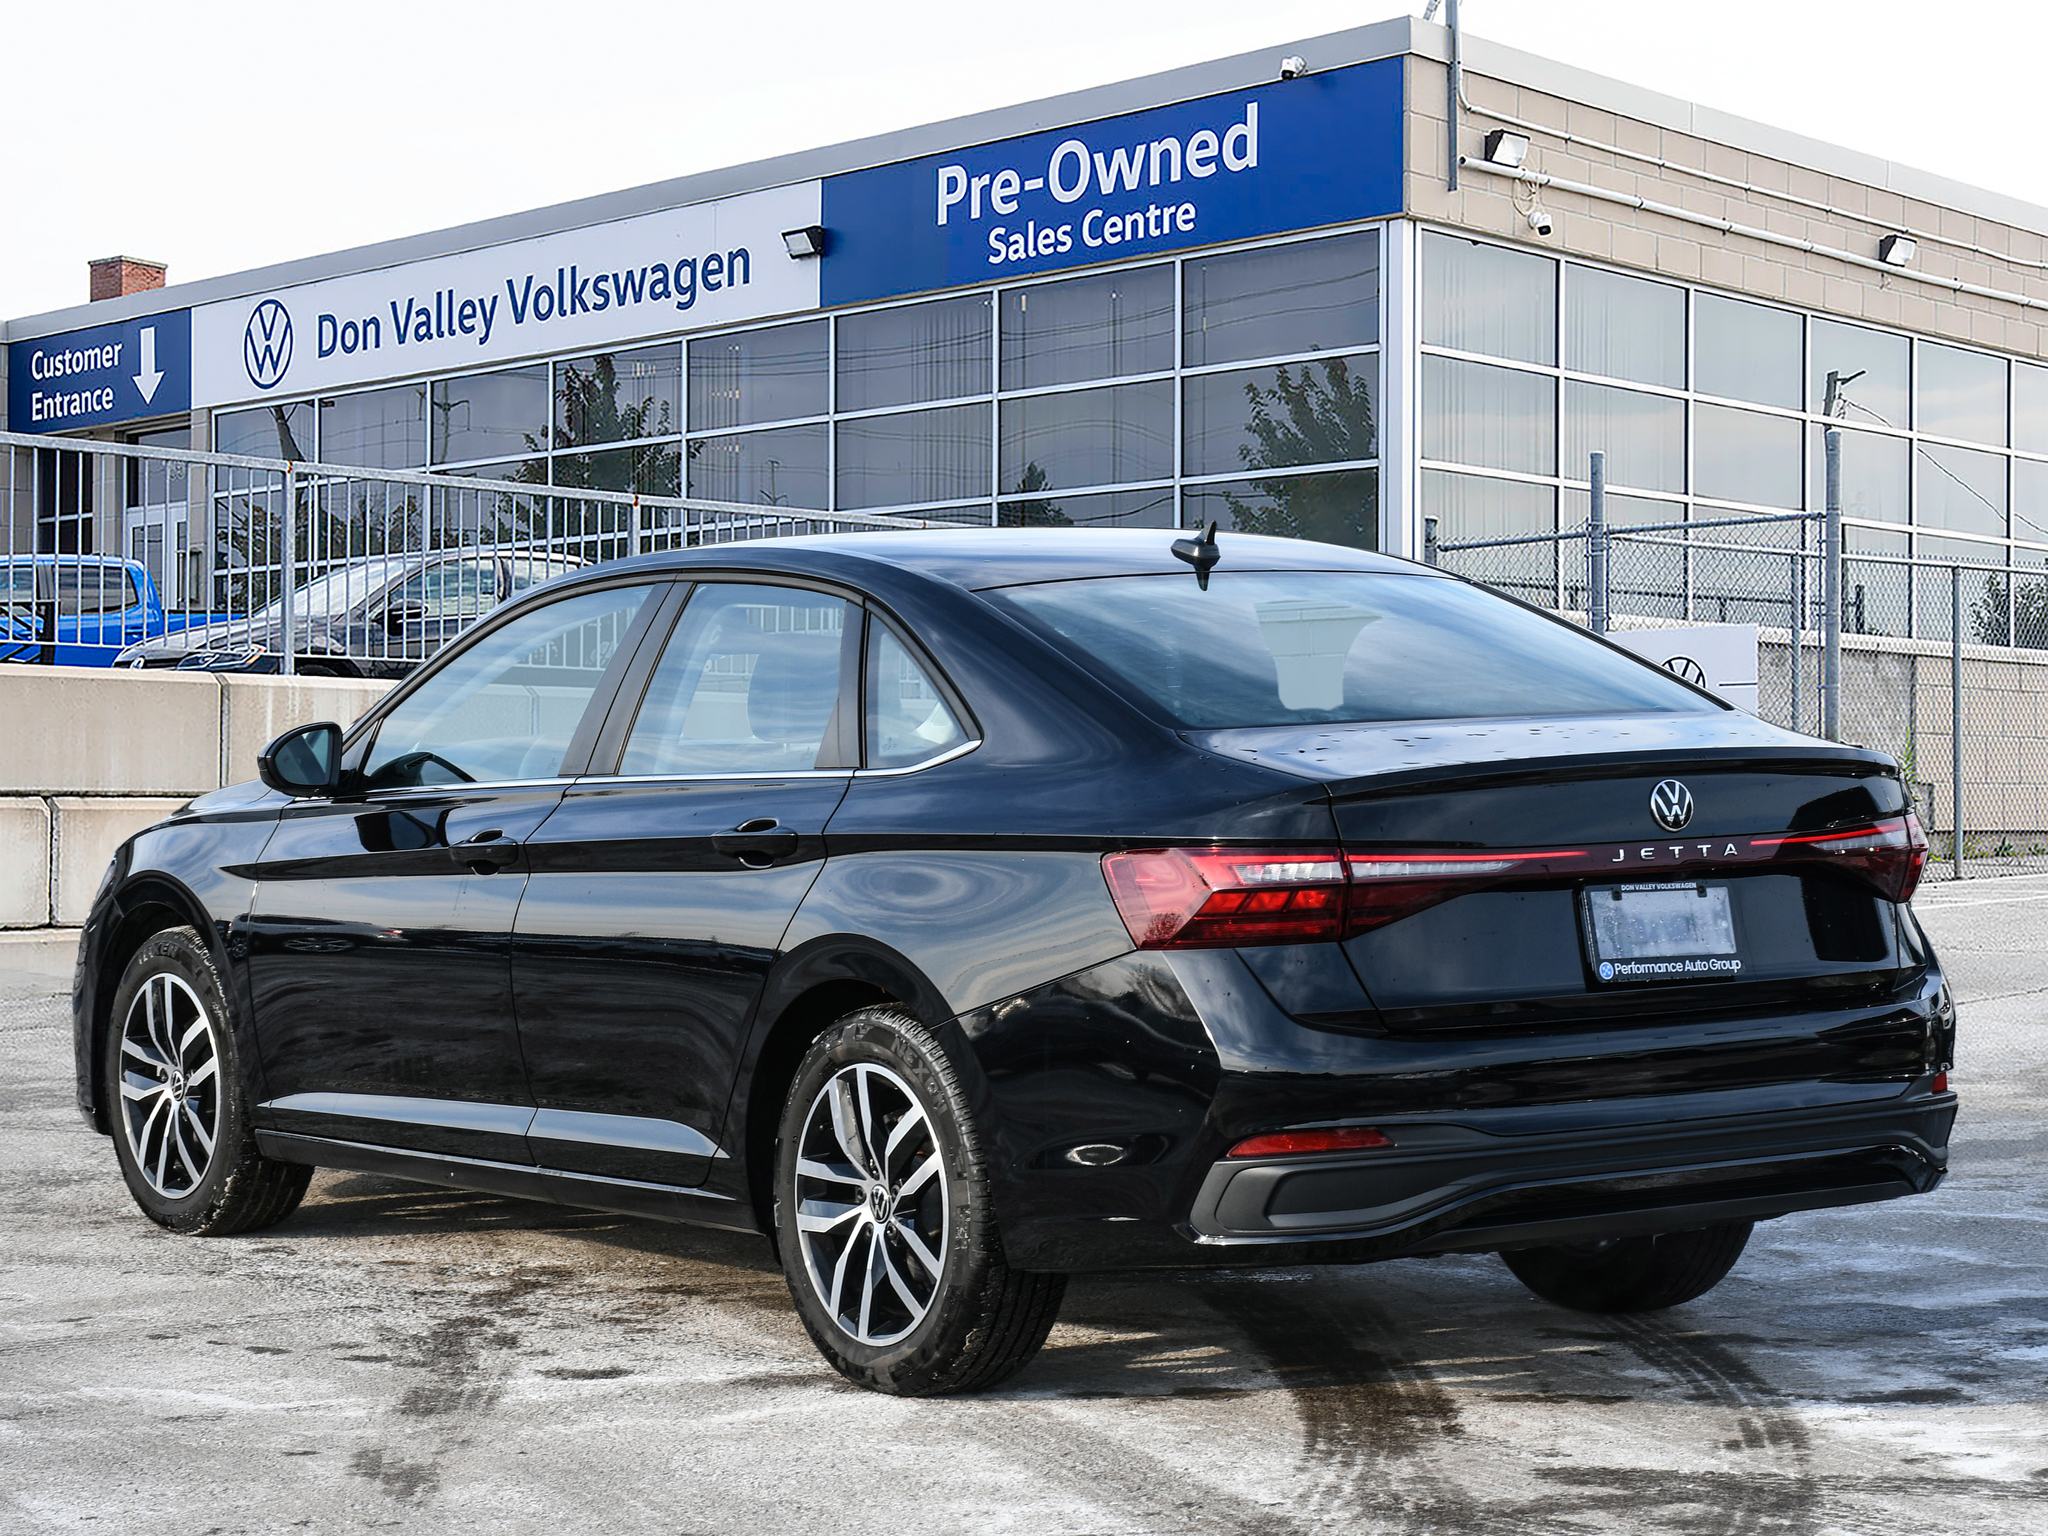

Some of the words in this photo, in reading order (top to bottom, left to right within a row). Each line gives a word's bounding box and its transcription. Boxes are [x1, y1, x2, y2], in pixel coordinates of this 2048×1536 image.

[936, 101, 1259, 226] Pre-Owned
[987, 220, 1072, 265] Sales
[1082, 202, 1197, 248] Centre
[317, 314, 381, 359] Don
[390, 290, 499, 346] Valley
[507, 246, 751, 325] Volkswagen
[31, 341, 123, 381] Customer
[31, 386, 114, 421] Entrance
[1611, 843, 1738, 863] JETTA
[1656, 882, 1697, 890] VOLKSWAGEN
[1614, 961, 1684, 975] Performance
[1684, 959, 1709, 972] Auto
[1709, 958, 1741, 973] Group
